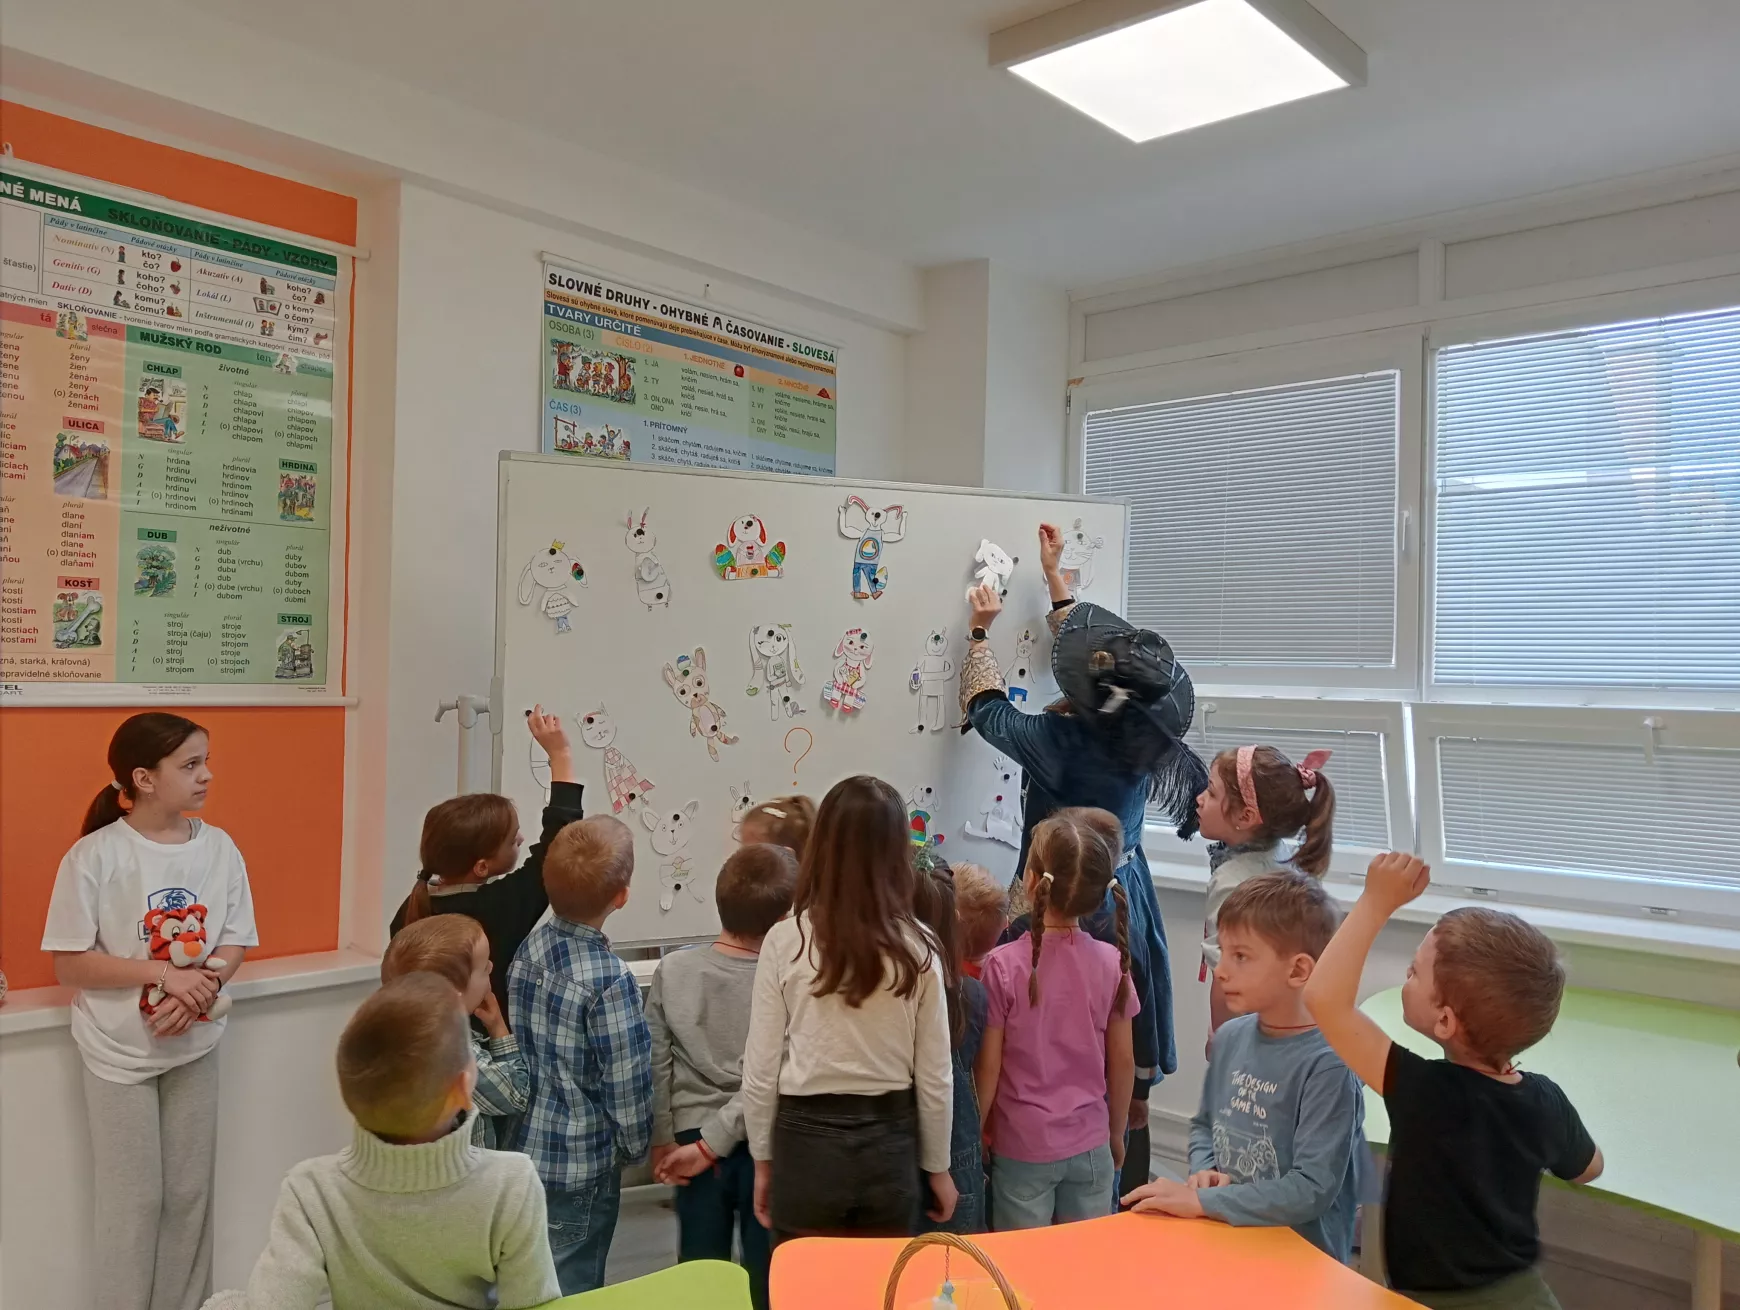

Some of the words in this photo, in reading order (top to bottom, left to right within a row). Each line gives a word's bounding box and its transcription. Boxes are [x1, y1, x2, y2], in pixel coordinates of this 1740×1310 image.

[30, 188, 82, 212] MENÁ
[108, 208, 220, 244] SKLOŇOVANIE
[233, 238, 270, 256] PÁDY
[283, 251, 328, 268] VZORY
[50, 217, 68, 228] Pády
[76, 224, 108, 236] latinčine
[131, 236, 154, 248] Pádové
[101, 244, 115, 256] (N)
[142, 250, 162, 260] kto?
[53, 258, 85, 272] Genitív
[87, 265, 101, 276] (G)
[143, 261, 160, 270] čo?
[137, 272, 166, 284] koho?
[232, 275, 244, 284] (A)
[52, 282, 76, 292] Datív
[78, 286, 92, 296] (D)
[136, 281, 165, 293] čoho?
[287, 283, 312, 294] koho?
[134, 293, 166, 304] komu?
[196, 289, 218, 299] Lokál
[220, 293, 232, 303] (L)
[292, 293, 306, 302] čo?
[29, 298, 48, 306] mien
[546, 290, 570, 302] Slovesá
[580, 300, 600, 312] ohybné
[602, 306, 618, 316] slová,
[134, 304, 166, 316] čomu?
[292, 304, 314, 314] kom?
[40, 313, 52, 322] tá
[195, 310, 244, 326] Inštrumentál
[246, 320, 254, 329] (I)
[292, 314, 314, 324] čom?
[548, 273, 602, 297] SLOVNÉ
[606, 288, 650, 310] DRUHY
[660, 304, 708, 326] OHYBNÉ
[726, 320, 784, 348] ČASOVANIE
[792, 342, 834, 363] SLOVESÁ
[548, 304, 591, 323] TVARY
[595, 316, 641, 336] URČITÉ
[58, 302, 117, 319] SKLOŇOVANIE
[124, 315, 152, 326] tvorenie
[153, 320, 174, 330] tvarov
[176, 325, 192, 334] mien
[194, 328, 213, 338] podľa
[214, 332, 256, 346] gramatických
[92, 324, 118, 334] slečna
[288, 324, 309, 334] kým?
[549, 320, 580, 336] OSOBA
[583, 329, 594, 340] (3)
[140, 330, 193, 348] MUŽSKÝ
[196, 342, 222, 354] ROD
[288, 334, 308, 344] čím?
[616, 336, 640, 350] ČÍSLO
[642, 344, 652, 354] (2)
[70, 352, 90, 363] ženy
[256, 353, 272, 362] ten
[690, 354, 726, 370] JEDNOTNÉ
[70, 362, 86, 371] žien
[147, 364, 178, 374] CHLAP
[218, 364, 250, 376] životné
[69, 372, 98, 382] ženám
[68, 392, 100, 402] ženách
[234, 390, 252, 398] chlap
[68, 401, 99, 412] ženami
[234, 399, 256, 408] chlapa
[662, 397, 674, 406] ONA
[234, 408, 264, 417] chlapovi
[288, 407, 314, 416] chlapov
[550, 400, 568, 412] ČAS
[570, 404, 582, 416] (3)
[68, 420, 100, 430] ULICA
[288, 416, 316, 425] chlapom
[650, 421, 688, 434] PRÍTOMNÝ
[287, 432, 318, 442] chlapoch
[286, 441, 313, 450] chlapmi
[166, 456, 190, 465] hrdina
[166, 466, 190, 474] hrdinu
[222, 464, 256, 474] hrdinovia
[282, 462, 315, 472] HRDINA
[166, 475, 196, 484] hrdinovi
[222, 472, 250, 481] hrdinov
[222, 482, 252, 490] hrdinom
[222, 499, 254, 508] hrdinoch
[62, 512, 85, 520] dlane
[222, 508, 253, 517] hrdinami
[210, 524, 250, 534] neživotné
[61, 530, 94, 540] dlaniam
[148, 532, 168, 540] DUB
[60, 550, 96, 558] dlaniach
[285, 554, 302, 562] duby
[60, 559, 94, 568] dlaňami
[64, 578, 92, 588] KOSŤ
[2, 586, 23, 595] kosti
[285, 588, 310, 596] duboch
[2, 606, 36, 615] kostiam
[281, 616, 309, 624] STROJ
[1, 626, 38, 634] kostiach
[168, 621, 184, 630] stroj
[222, 623, 242, 631] stroje
[168, 630, 188, 638] stroja
[222, 632, 246, 640] strojov
[1, 636, 37, 644] kosťami
[166, 640, 188, 648] stroju
[222, 640, 248, 648] strojom
[20, 657, 49, 666] starká,
[52, 658, 90, 667] kráľovná)
[166, 657, 184, 665] stroji
[220, 658, 250, 666] strojoch
[52, 670, 102, 679] skloňovanie
[220, 667, 244, 675] strojmi
[784, 727, 812, 786] ?
[1232, 1070, 1246, 1086] THE
[1246, 1074, 1278, 1094] DESIGN
[1238, 1087, 1248, 1097] OF
[1231, 1096, 1251, 1114] GAME
[1254, 1104, 1266, 1119] PAD
